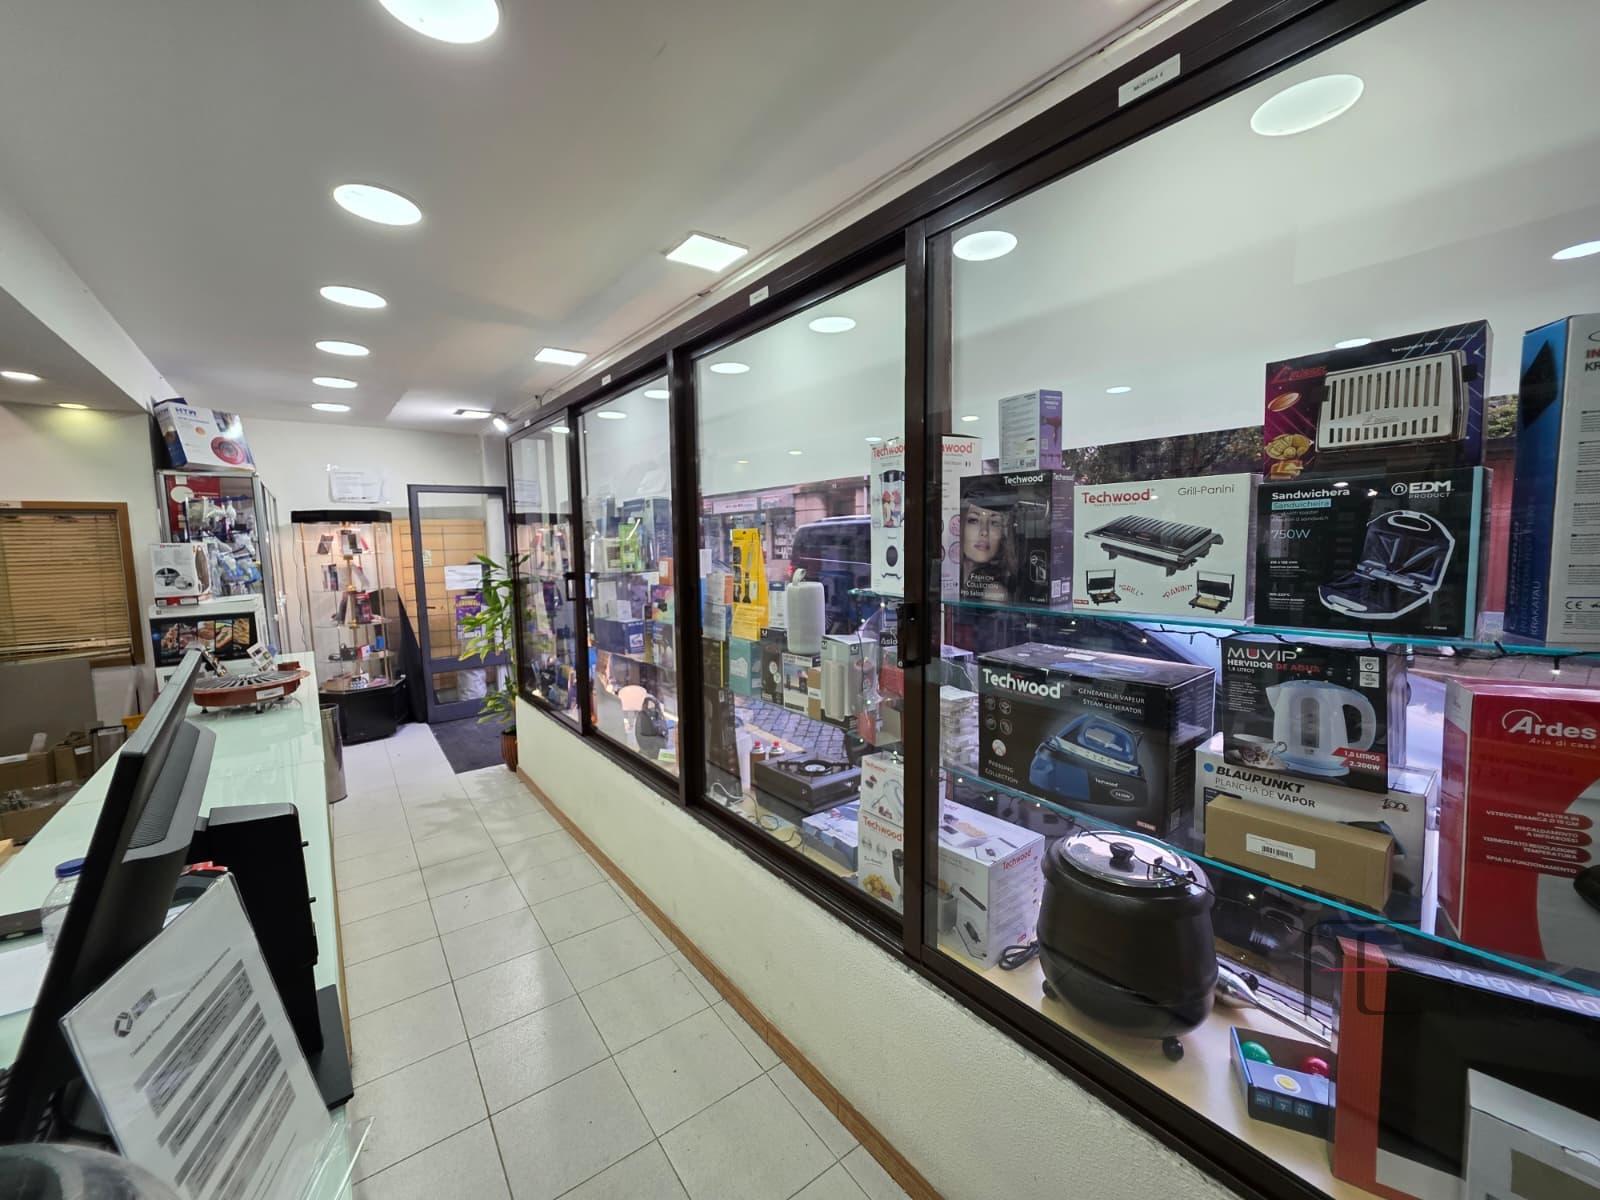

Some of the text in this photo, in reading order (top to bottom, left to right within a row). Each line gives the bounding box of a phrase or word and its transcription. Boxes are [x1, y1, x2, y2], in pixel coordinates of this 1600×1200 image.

[1003, 473, 1046, 485] Techwood
[1178, 484, 1235, 496] Grill-Panini
[1409, 480, 1451, 494] EDM
[1082, 488, 1150, 504] Techwood
[1272, 489, 1350, 500] Sandwichera
[1271, 528, 1311, 539] 750W
[1227, 647, 1297, 662] MUVIP
[1227, 659, 1273, 669] HERVIDOR
[982, 668, 1060, 699] Techwood
[1508, 716, 1597, 740] Ardes
[1355, 752, 1380, 762] LITROS
[1215, 766, 1305, 793] BLAUPUNKT
[1215, 777, 1316, 808] PLANCHA DE VAPOR
[1002, 848, 1032, 871] Techwood
